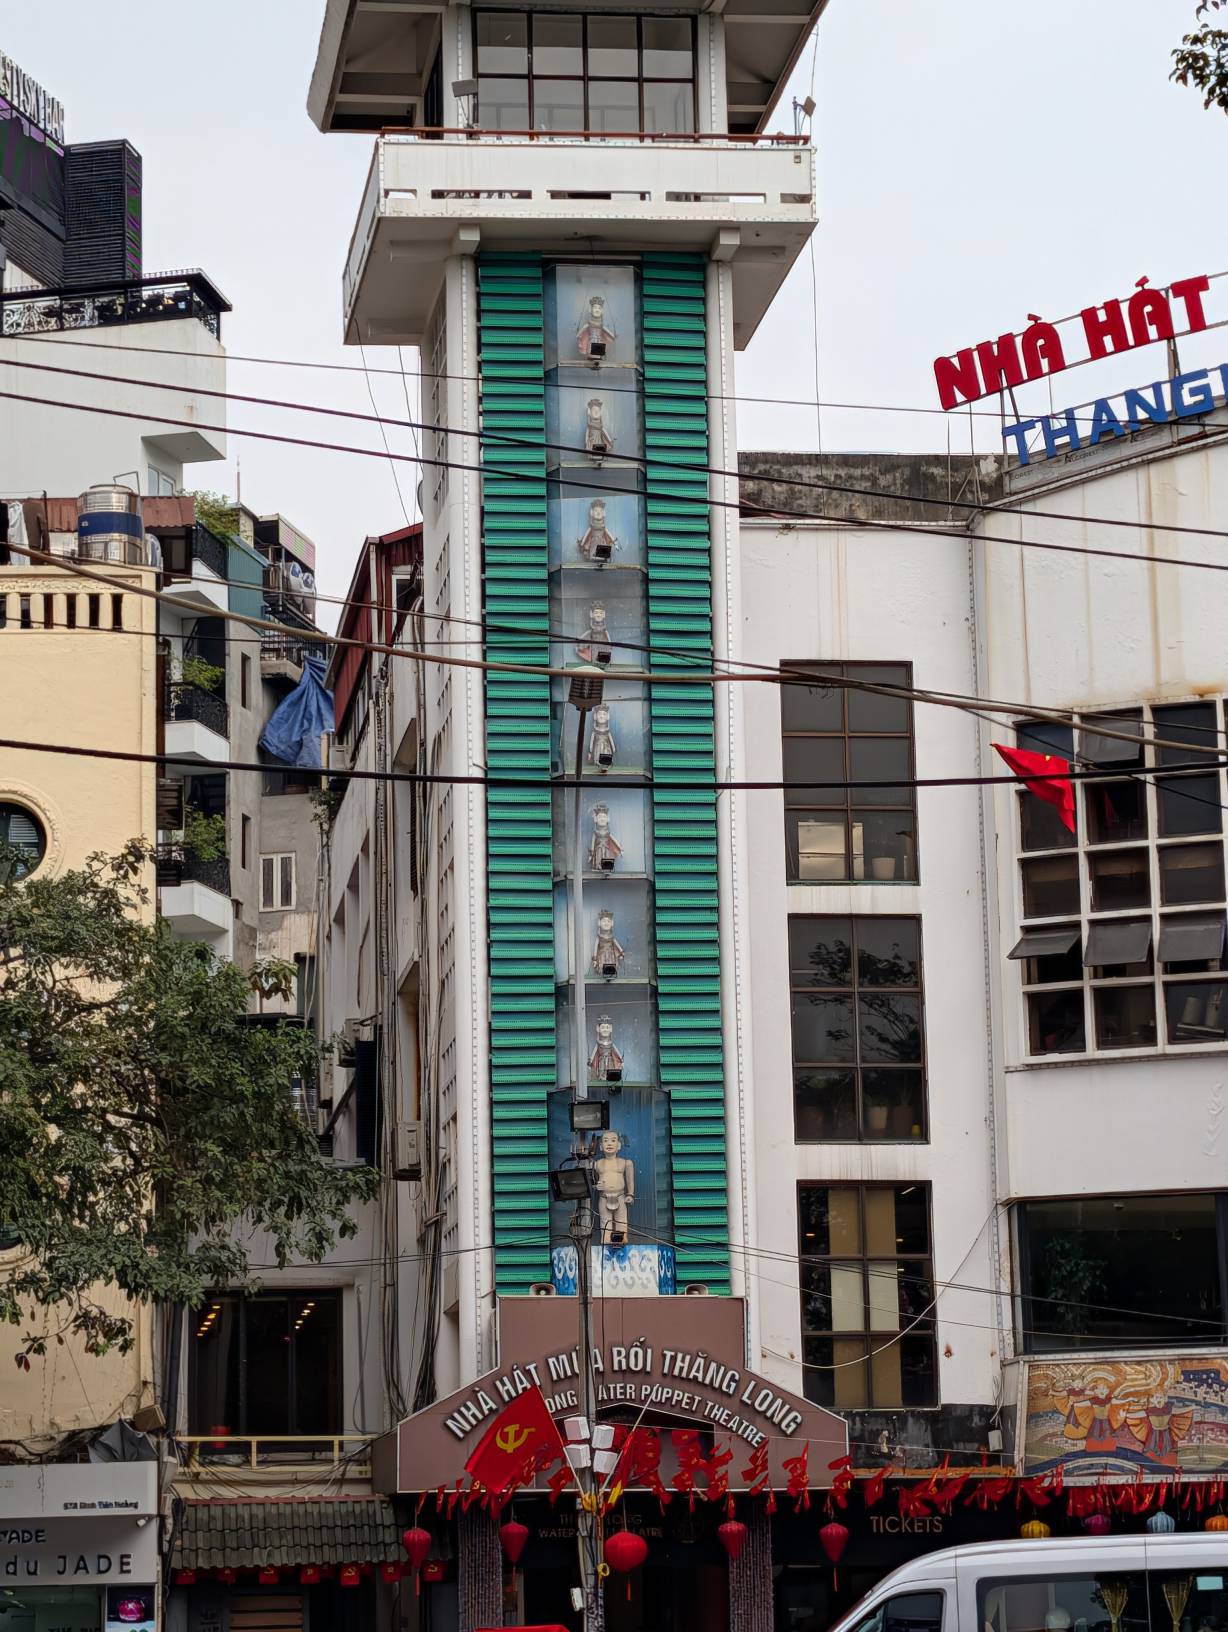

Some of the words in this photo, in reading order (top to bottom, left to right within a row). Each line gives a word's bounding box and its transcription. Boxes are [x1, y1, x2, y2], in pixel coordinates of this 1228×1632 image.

[934, 313, 1066, 411] NHÀ
[1080, 275, 1210, 361] HÁT
[445, 1386, 498, 1439] NHÀ
[495, 1361, 541, 1402] HÁT
[611, 1336, 652, 1373] RỐI
[662, 1350, 740, 1396] THĂNG
[742, 1380, 802, 1436] LONG
[545, 1390, 578, 1414] ONG
[598, 1383, 636, 1401] ATER
[640, 1384, 702, 1411] PUPPET
[703, 1400, 767, 1448] THEATRE
[869, 1516, 943, 1533] TICKETS
[6, 1555, 38, 1576] du
[56, 1553, 132, 1576] JADE
